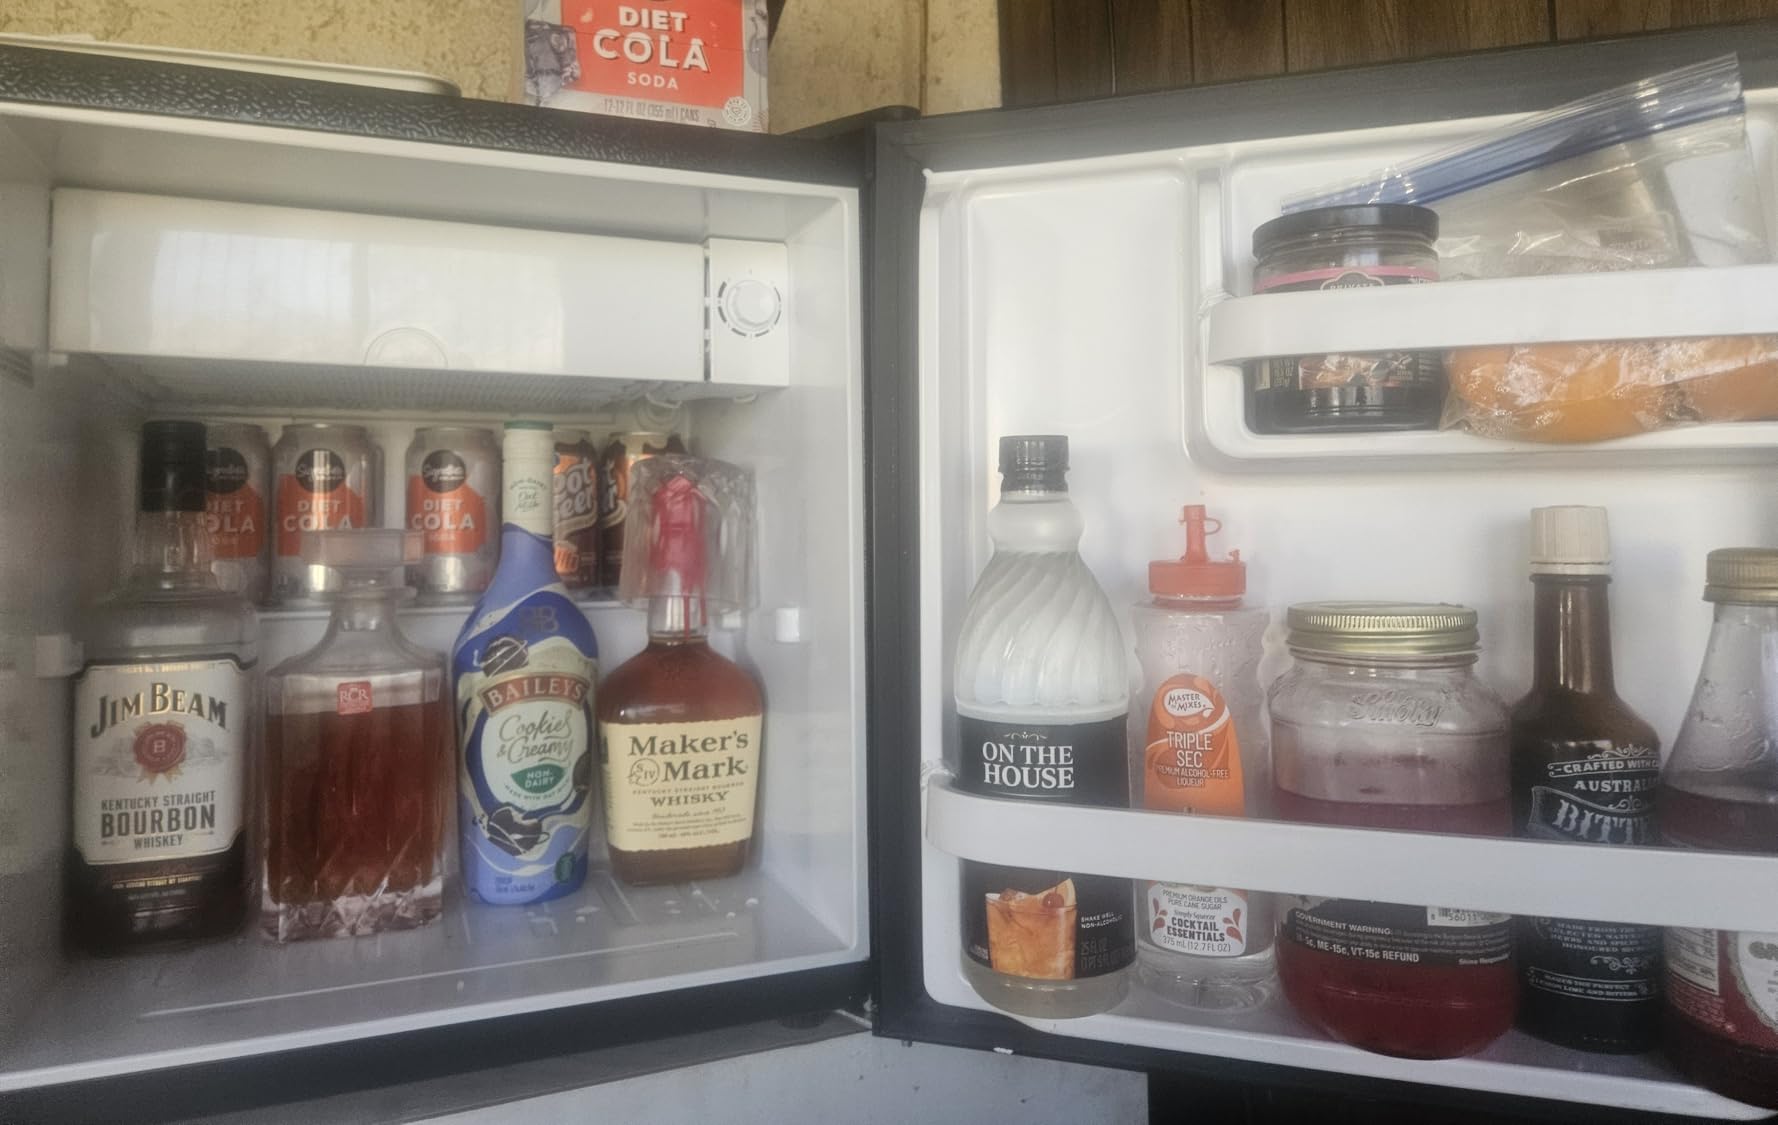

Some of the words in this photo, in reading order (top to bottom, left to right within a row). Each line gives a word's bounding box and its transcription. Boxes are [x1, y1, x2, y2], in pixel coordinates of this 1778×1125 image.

[618, 6, 688, 32] DIET
[593, 28, 711, 72] COLA
[627, 71, 679, 90] SODA
[423, 499, 462, 512] DIET
[412, 512, 475, 531] COLA
[487, 676, 583, 708] BAILEYS
[1167, 693, 1200, 707] MASTER
[90, 692, 143, 739] JIM
[147, 681, 228, 731] BEAM
[1176, 700, 1202, 712] MIXES
[499, 709, 573, 742] Cookies
[628, 729, 749, 756] Maker's
[1166, 730, 1213, 751] TRIPLE
[508, 736, 574, 769] Creamy
[982, 741, 1014, 764] ON
[1020, 744, 1074, 766] THE
[1176, 749, 1203, 768] SEC
[526, 768, 553, 780] NON-
[661, 756, 746, 783] Mark
[983, 762, 1075, 789] HOUSE
[1180, 767, 1229, 779] ALCOHOL-FREE
[1563, 761, 1625, 774] CRAFTED
[1627, 759, 1651, 769] WITH
[524, 777, 555, 789] DAIRY
[1176, 777, 1205, 787] LIQUEUR
[101, 796, 159, 811] KENTUCKY
[163, 791, 216, 806] STRAIGHT
[650, 790, 729, 807] WHISKY
[101, 804, 216, 838] BOURBON
[133, 834, 184, 849] WHISKEY
[1162, 889, 1187, 901] PREMIUM
[1167, 898, 1182, 907] PURE
[1183, 900, 1199, 909] CANE
[1200, 902, 1222, 910] SUGAR
[1171, 916, 1220, 932] COCKTAIL
[1295, 911, 1347, 930] GOVERNMENT
[1348, 924, 1393, 936] WARNING:
[1162, 936, 1176, 946] 375
[1166, 925, 1226, 942] ESSENTIALS
[1382, 951, 1420, 963] REFUND
